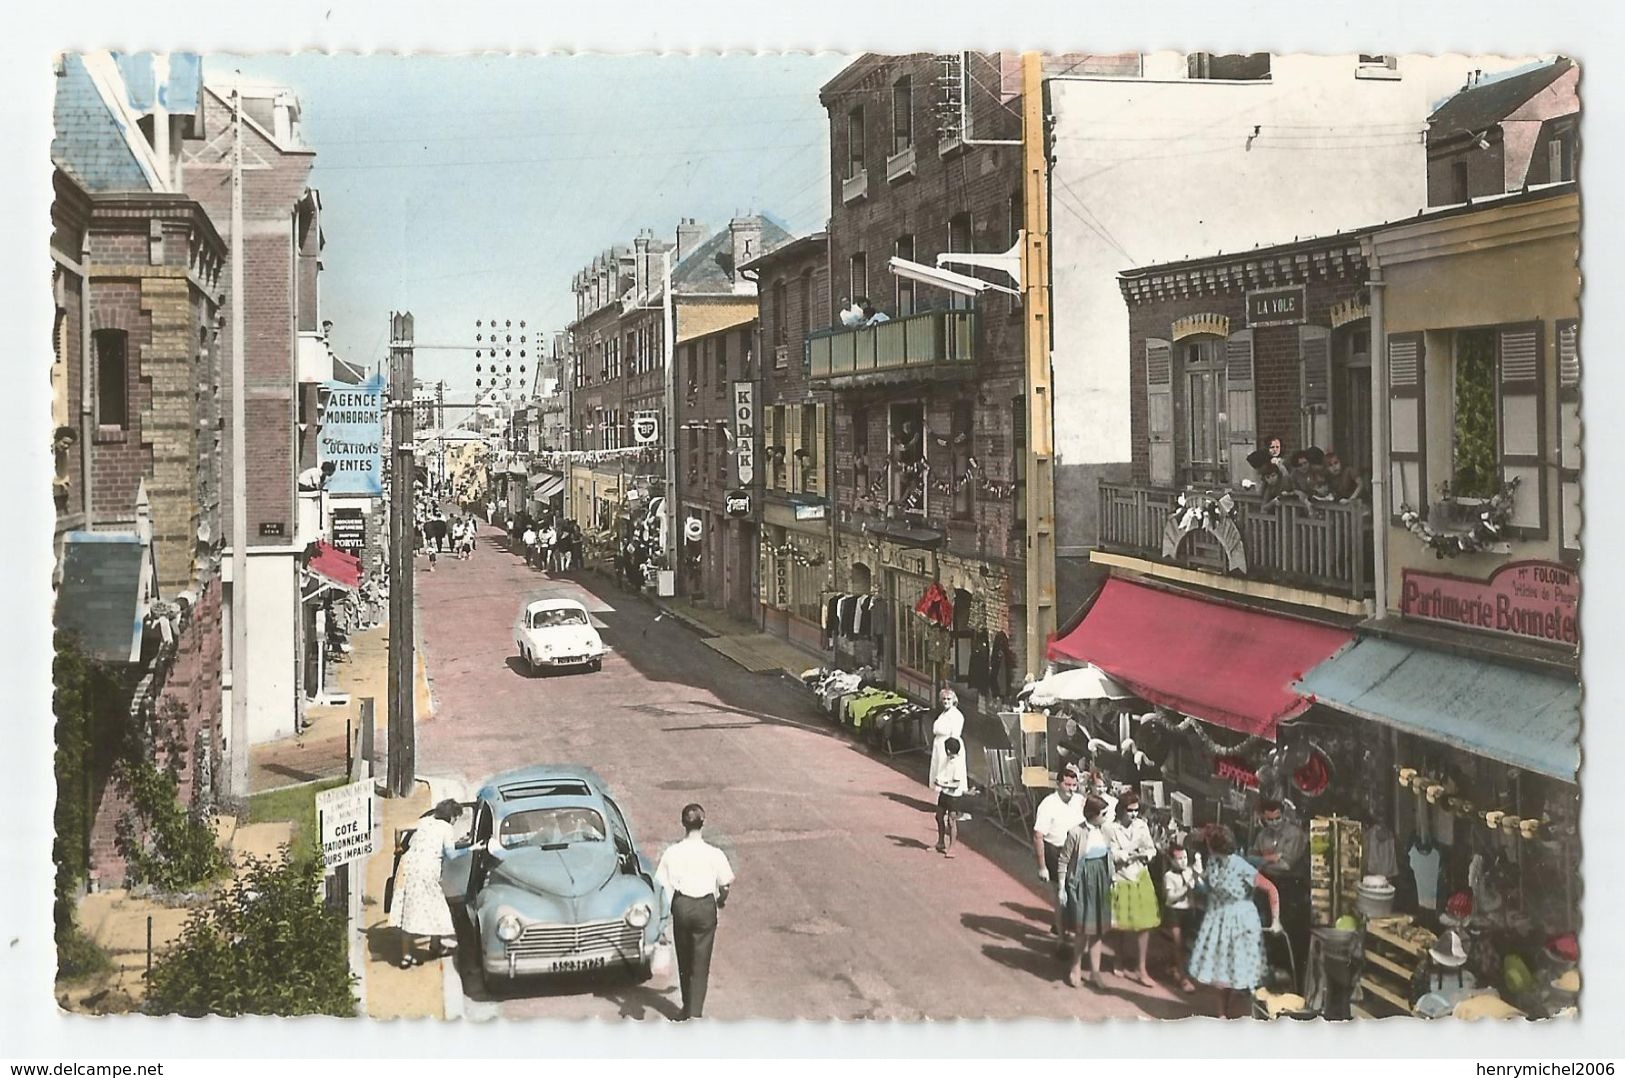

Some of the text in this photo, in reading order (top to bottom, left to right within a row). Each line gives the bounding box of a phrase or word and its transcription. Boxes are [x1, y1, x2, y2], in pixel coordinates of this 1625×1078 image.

[1257, 297, 1295, 315] LA YOLE
[329, 393, 377, 407] AGENCE
[326, 410, 379, 424] MONBORGNE
[640, 423, 654, 434] BP
[737, 391, 752, 467] KODAK
[326, 442, 379, 455] OCATIONS
[1403, 579, 1494, 629] Parfumerie
[344, 843, 373, 860] IMPAIRS
